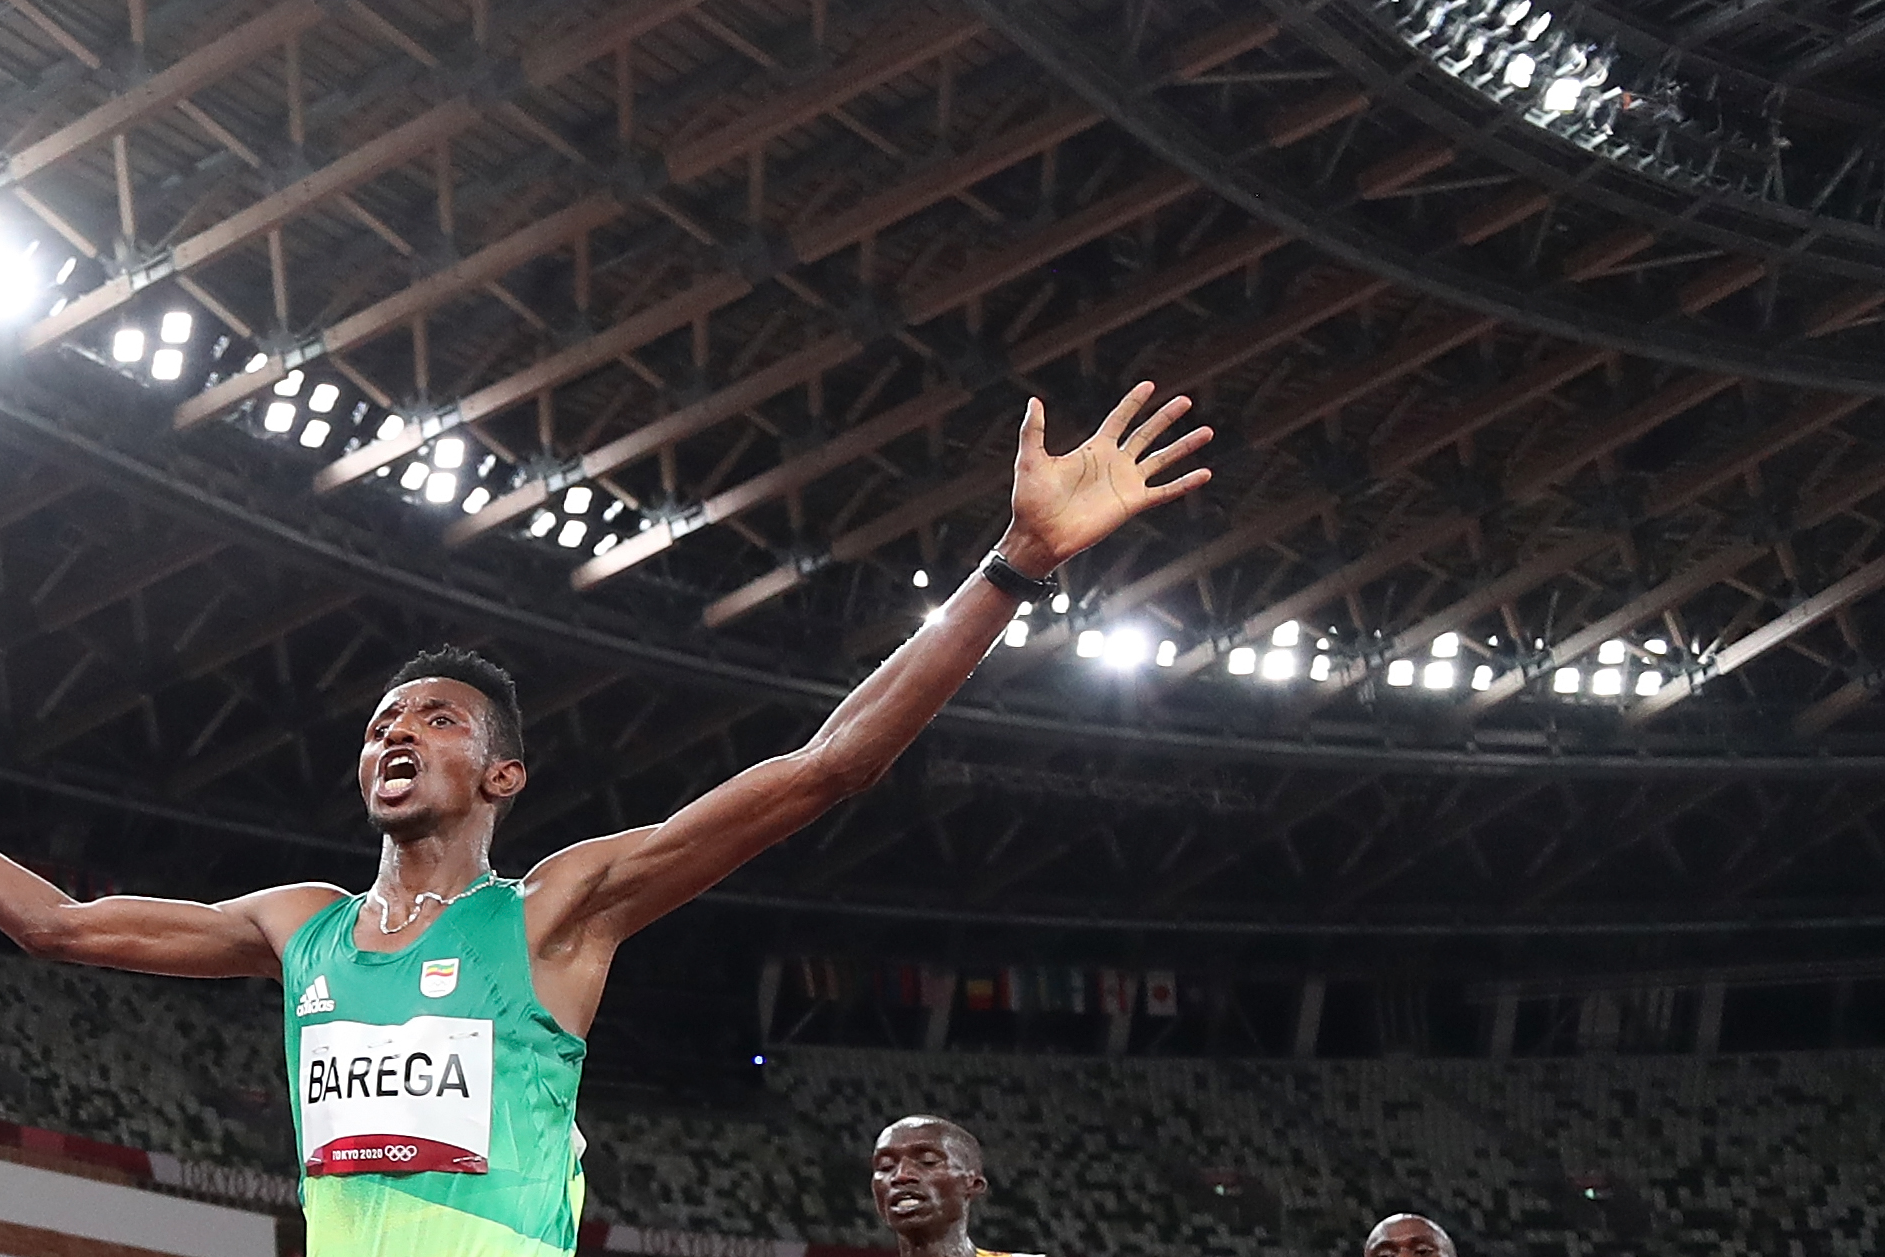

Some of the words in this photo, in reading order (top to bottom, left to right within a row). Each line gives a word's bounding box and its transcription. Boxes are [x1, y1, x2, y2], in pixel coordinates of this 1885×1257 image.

[296, 998, 336, 1017] adidas
[307, 1051, 470, 1104] BAREGA
[332, 1149, 359, 1160] TOKYO
[360, 1149, 383, 1159] 2020
